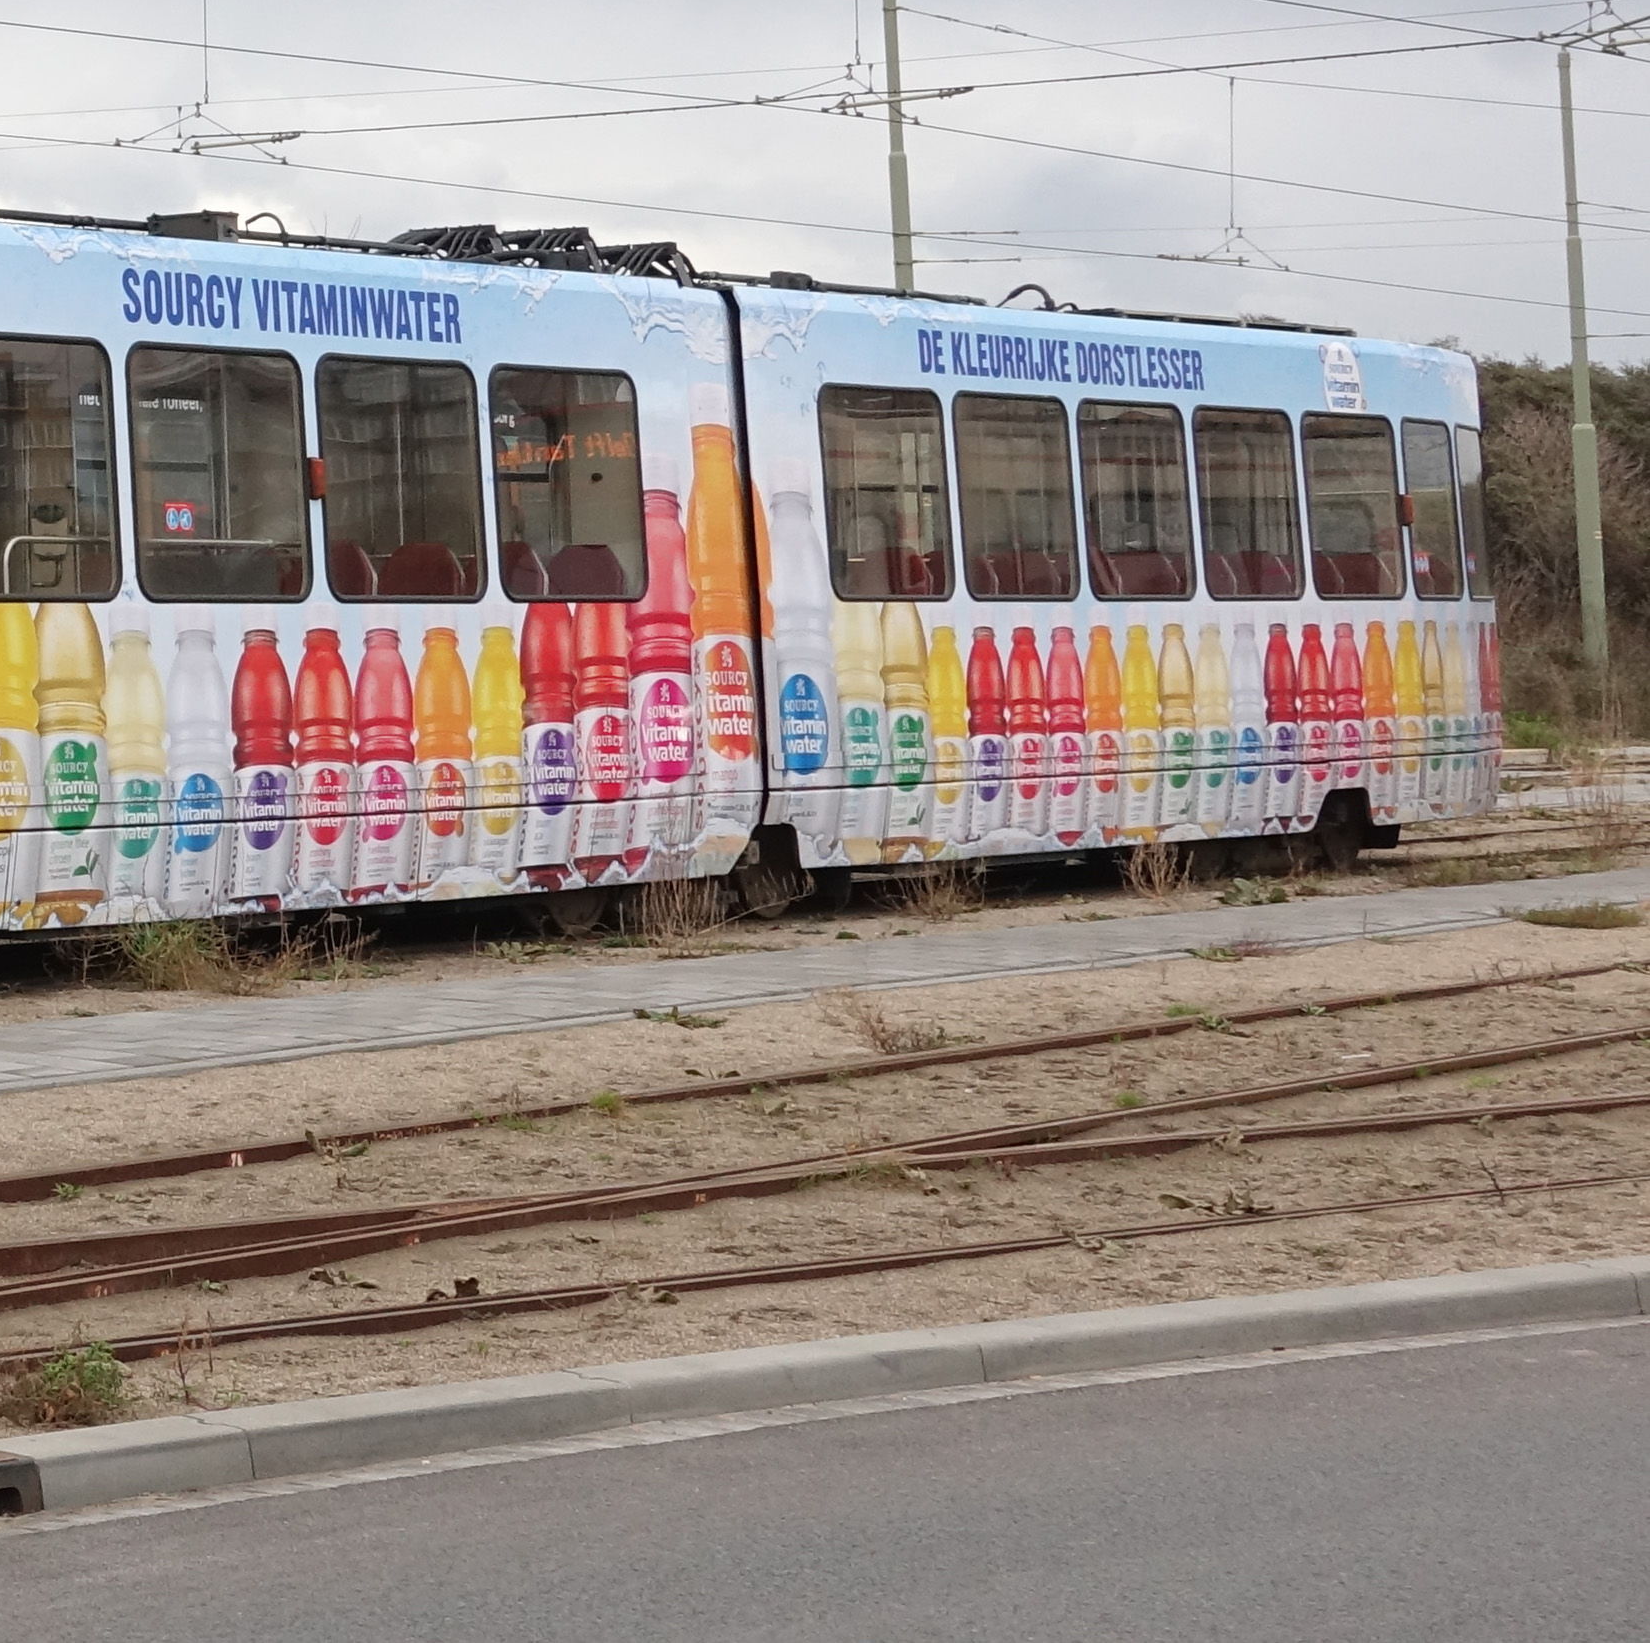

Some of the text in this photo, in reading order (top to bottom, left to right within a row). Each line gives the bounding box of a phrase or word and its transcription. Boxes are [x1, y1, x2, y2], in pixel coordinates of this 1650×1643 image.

[122, 268, 461, 344] SOURCY VITAMINWATER
[918, 329, 1205, 391] DE KLEURRIJKE DORSTLESSER
[1331, 395, 1356, 408] water
[704, 671, 749, 686] SOURCY
[783, 699, 819, 712] SOURCY
[591, 734, 624, 747] SOURCY
[785, 737, 823, 754] water
[647, 743, 689, 763] water
